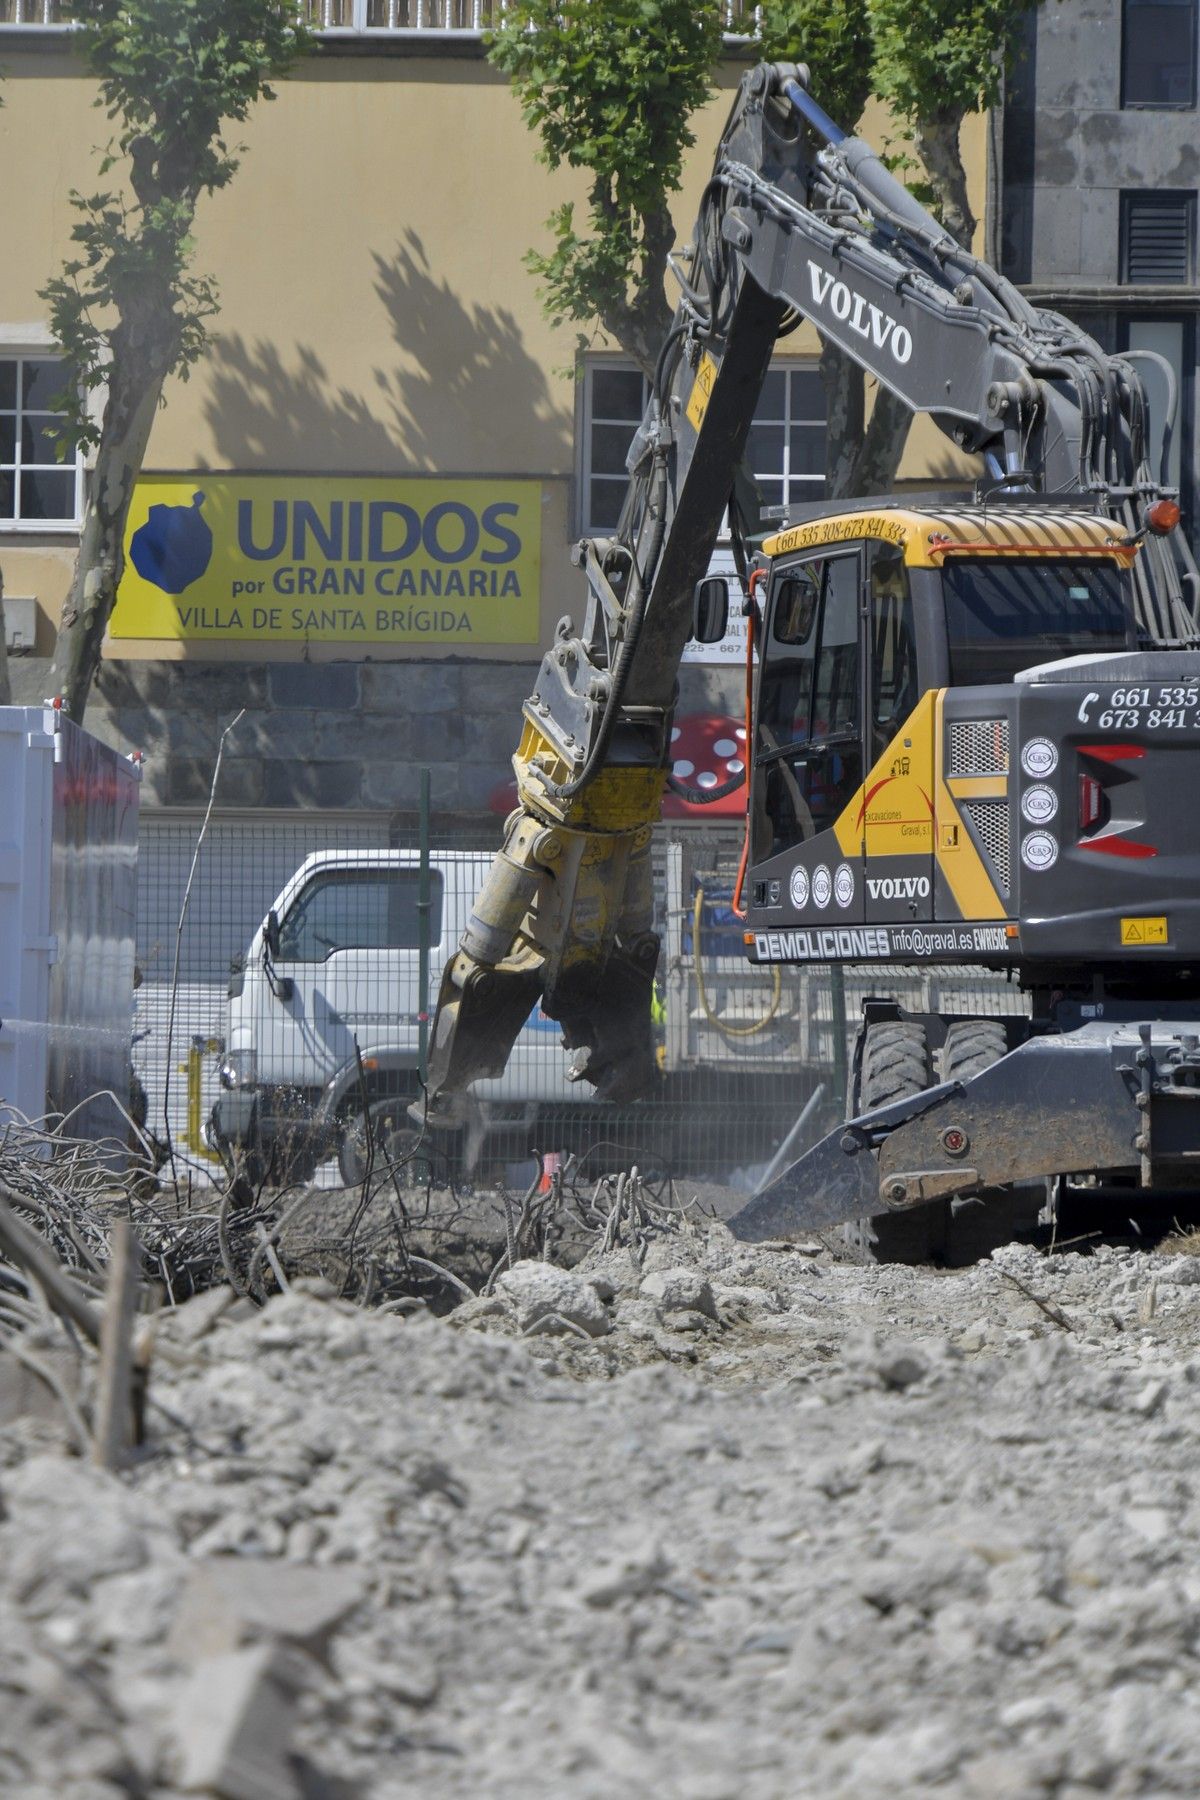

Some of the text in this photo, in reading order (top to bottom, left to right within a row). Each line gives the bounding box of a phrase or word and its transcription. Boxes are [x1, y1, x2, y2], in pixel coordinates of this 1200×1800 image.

[807, 259, 912, 363] VOLVO
[237, 499, 522, 564] UNIDOS
[781, 530, 798, 550] 661
[800, 525, 820, 546] 535
[232, 566, 522, 598] por GRAN CANARIA
[177, 605, 472, 632] VILLA DE SANTA BRÍGIDA
[1111, 687, 1199, 707] 661 535
[1099, 709, 1140, 728] 673
[1146, 709, 1187, 728] 841
[866, 876, 930, 899] VOLVO
[755, 929, 890, 960] DEMOLICIONES
[892, 928, 973, 955] info@graval.es
